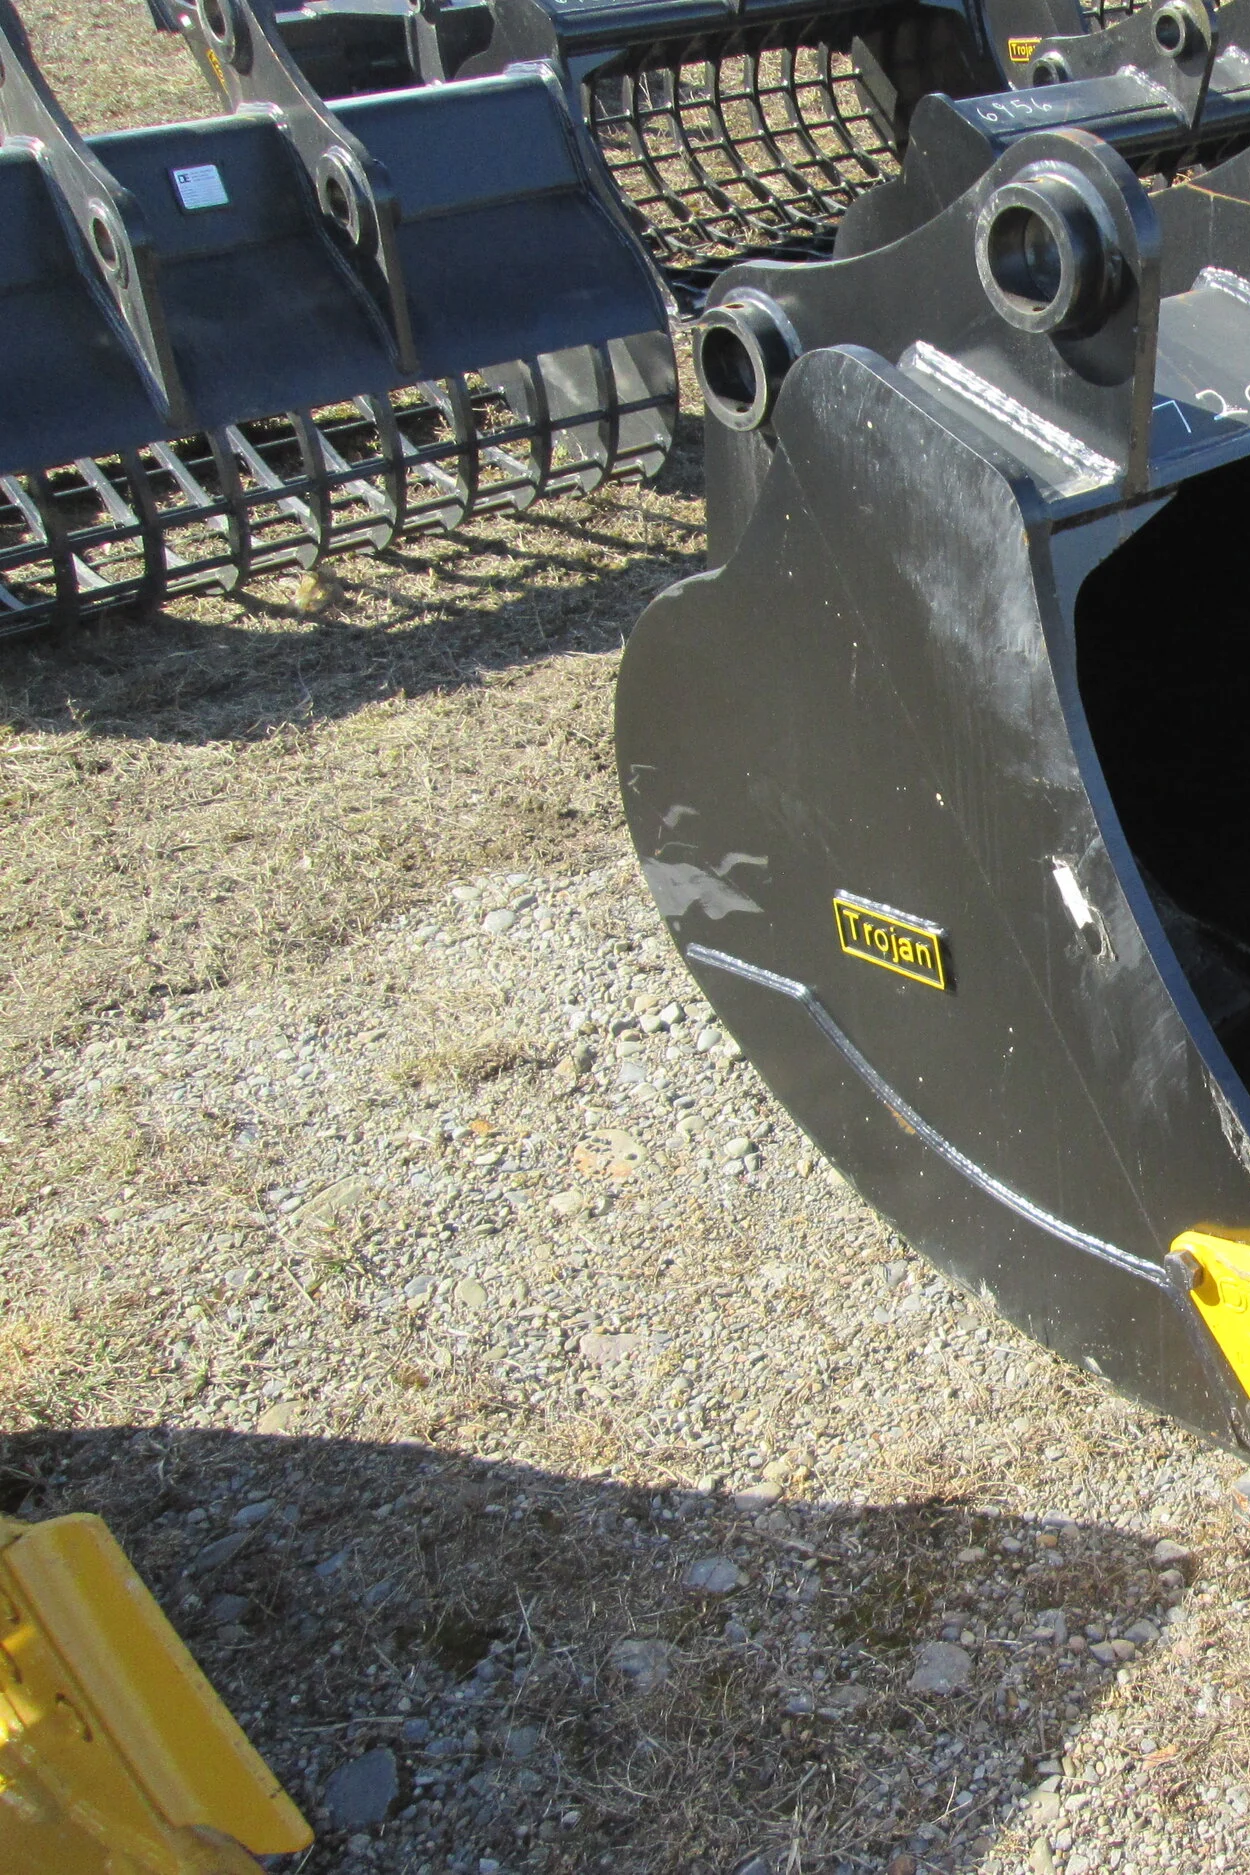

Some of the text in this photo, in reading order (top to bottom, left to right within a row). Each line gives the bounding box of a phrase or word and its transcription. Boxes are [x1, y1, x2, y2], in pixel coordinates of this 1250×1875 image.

[1011, 43, 1036, 58] Troja
[976, 97, 1053, 122] 6956
[842, 909, 933, 969] Trojan
